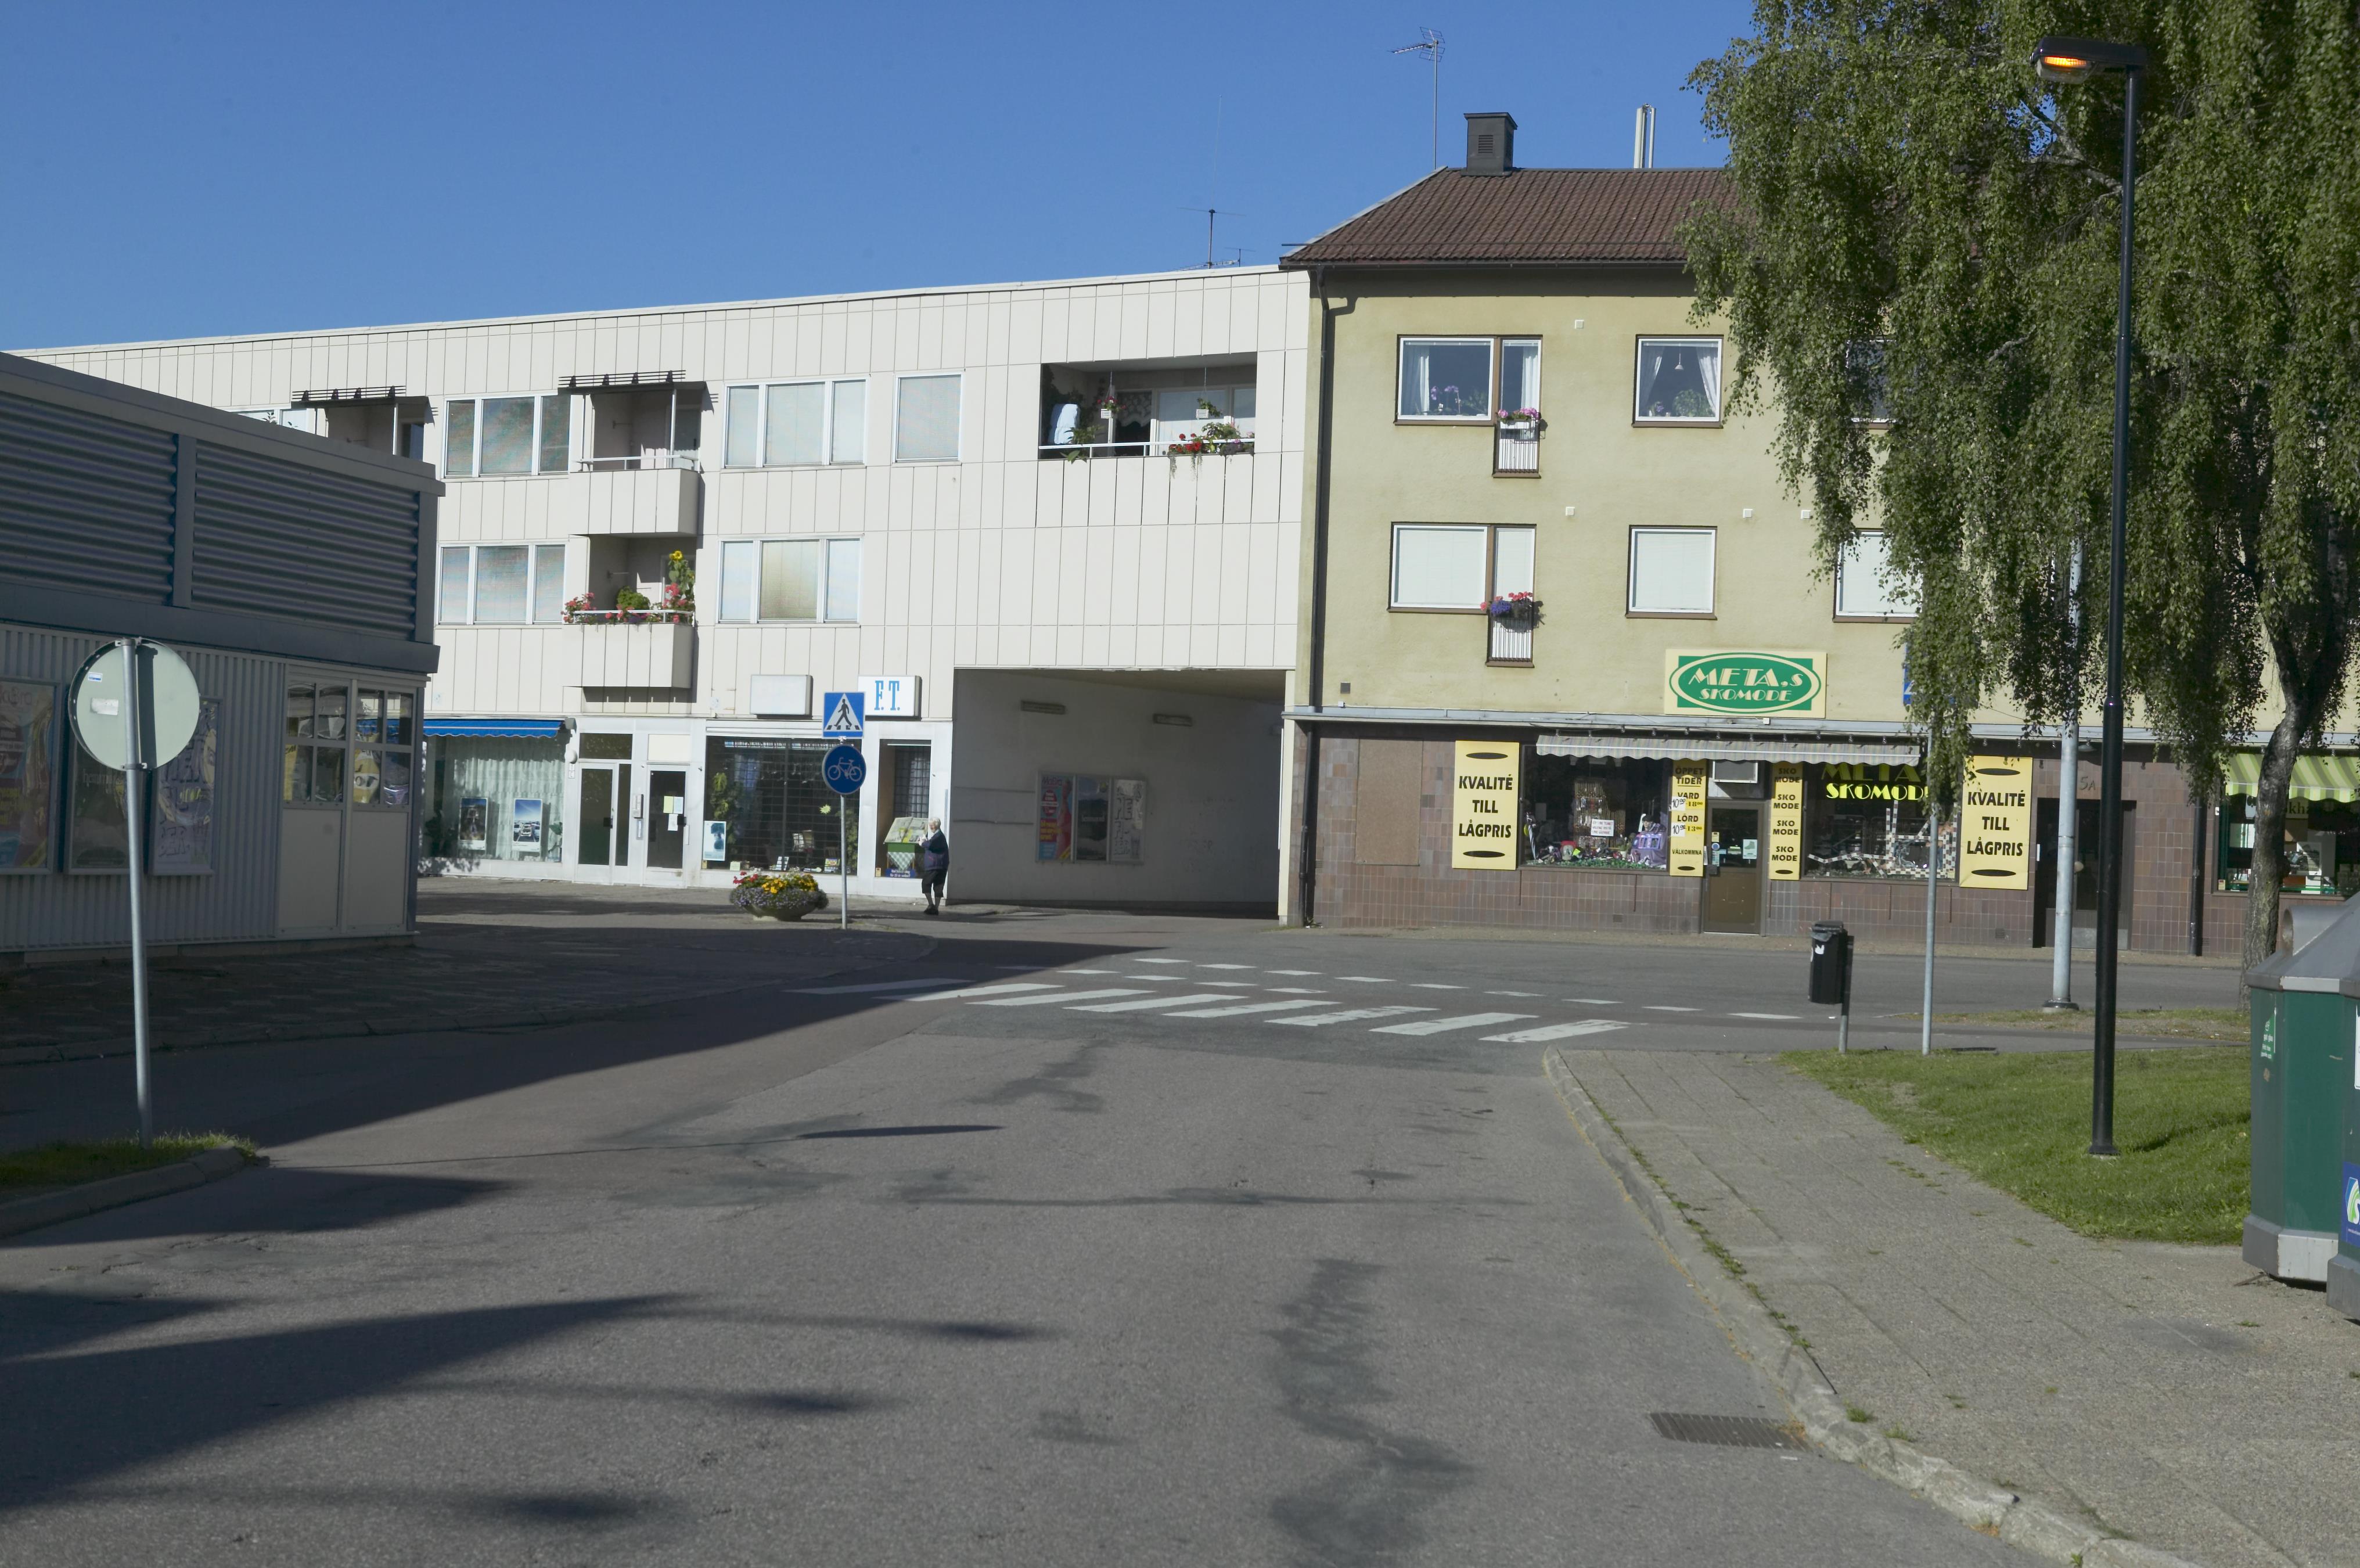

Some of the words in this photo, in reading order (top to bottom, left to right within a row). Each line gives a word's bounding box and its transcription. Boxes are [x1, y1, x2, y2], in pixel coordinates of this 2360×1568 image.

[1699, 688, 1792, 702] SKOMODE
[1675, 766, 1704, 775] ÖPPET
[1458, 774, 1513, 790] KVALITÉ
[1967, 790, 2026, 807] KVALITÉ
[1472, 800, 1498, 813] TILL
[1677, 814, 1699, 822] LÖRD
[1982, 816, 2010, 830] TILL
[1458, 819, 1512, 838] LÅGPRIS
[1967, 836, 2023, 856] LÅGPRIS
